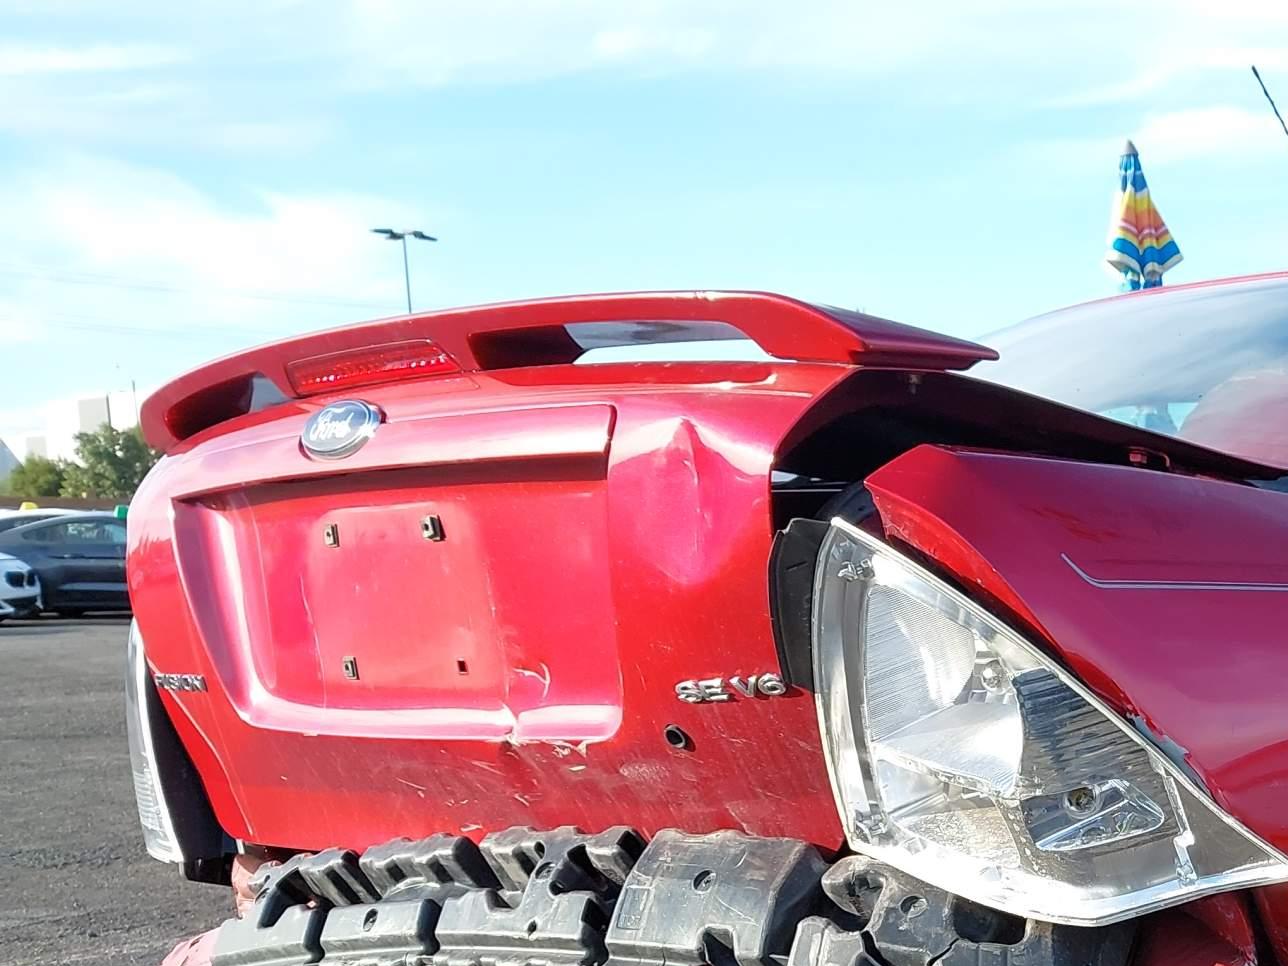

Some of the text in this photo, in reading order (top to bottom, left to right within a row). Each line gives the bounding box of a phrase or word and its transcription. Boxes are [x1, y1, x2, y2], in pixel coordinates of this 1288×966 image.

[309, 406, 354, 441] Ford
[675, 673, 786, 702] SE V6
